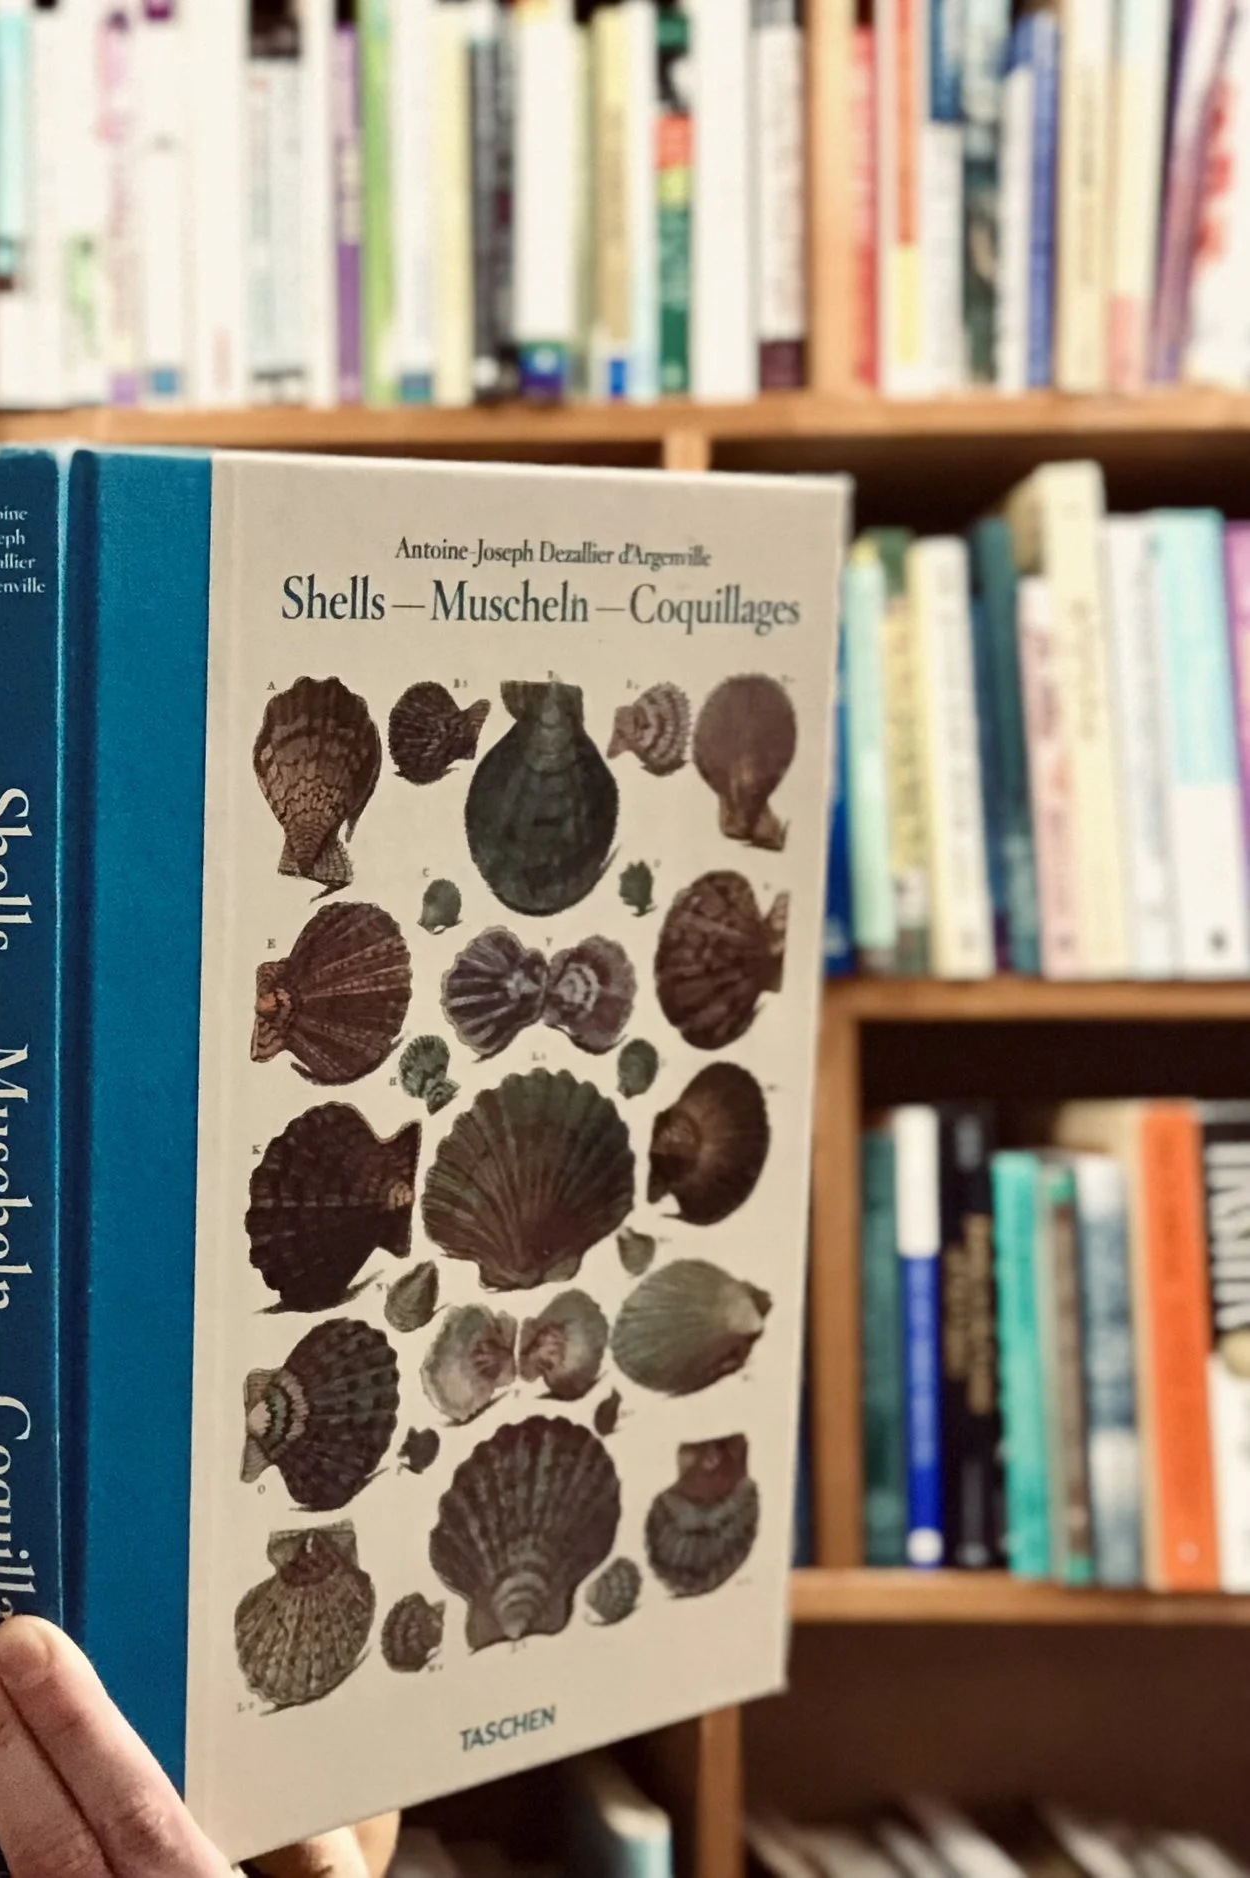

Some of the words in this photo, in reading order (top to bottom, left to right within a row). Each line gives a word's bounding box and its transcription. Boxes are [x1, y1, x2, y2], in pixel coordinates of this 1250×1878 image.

[540, 540, 615, 564] Dezallier
[618, 542, 713, 572] d'Argenville
[281, 574, 386, 621] Shells
[430, 578, 590, 623] Muscheln
[629, 583, 801, 637] Coquillages
[459, 1703, 556, 1751] TASCHEN
